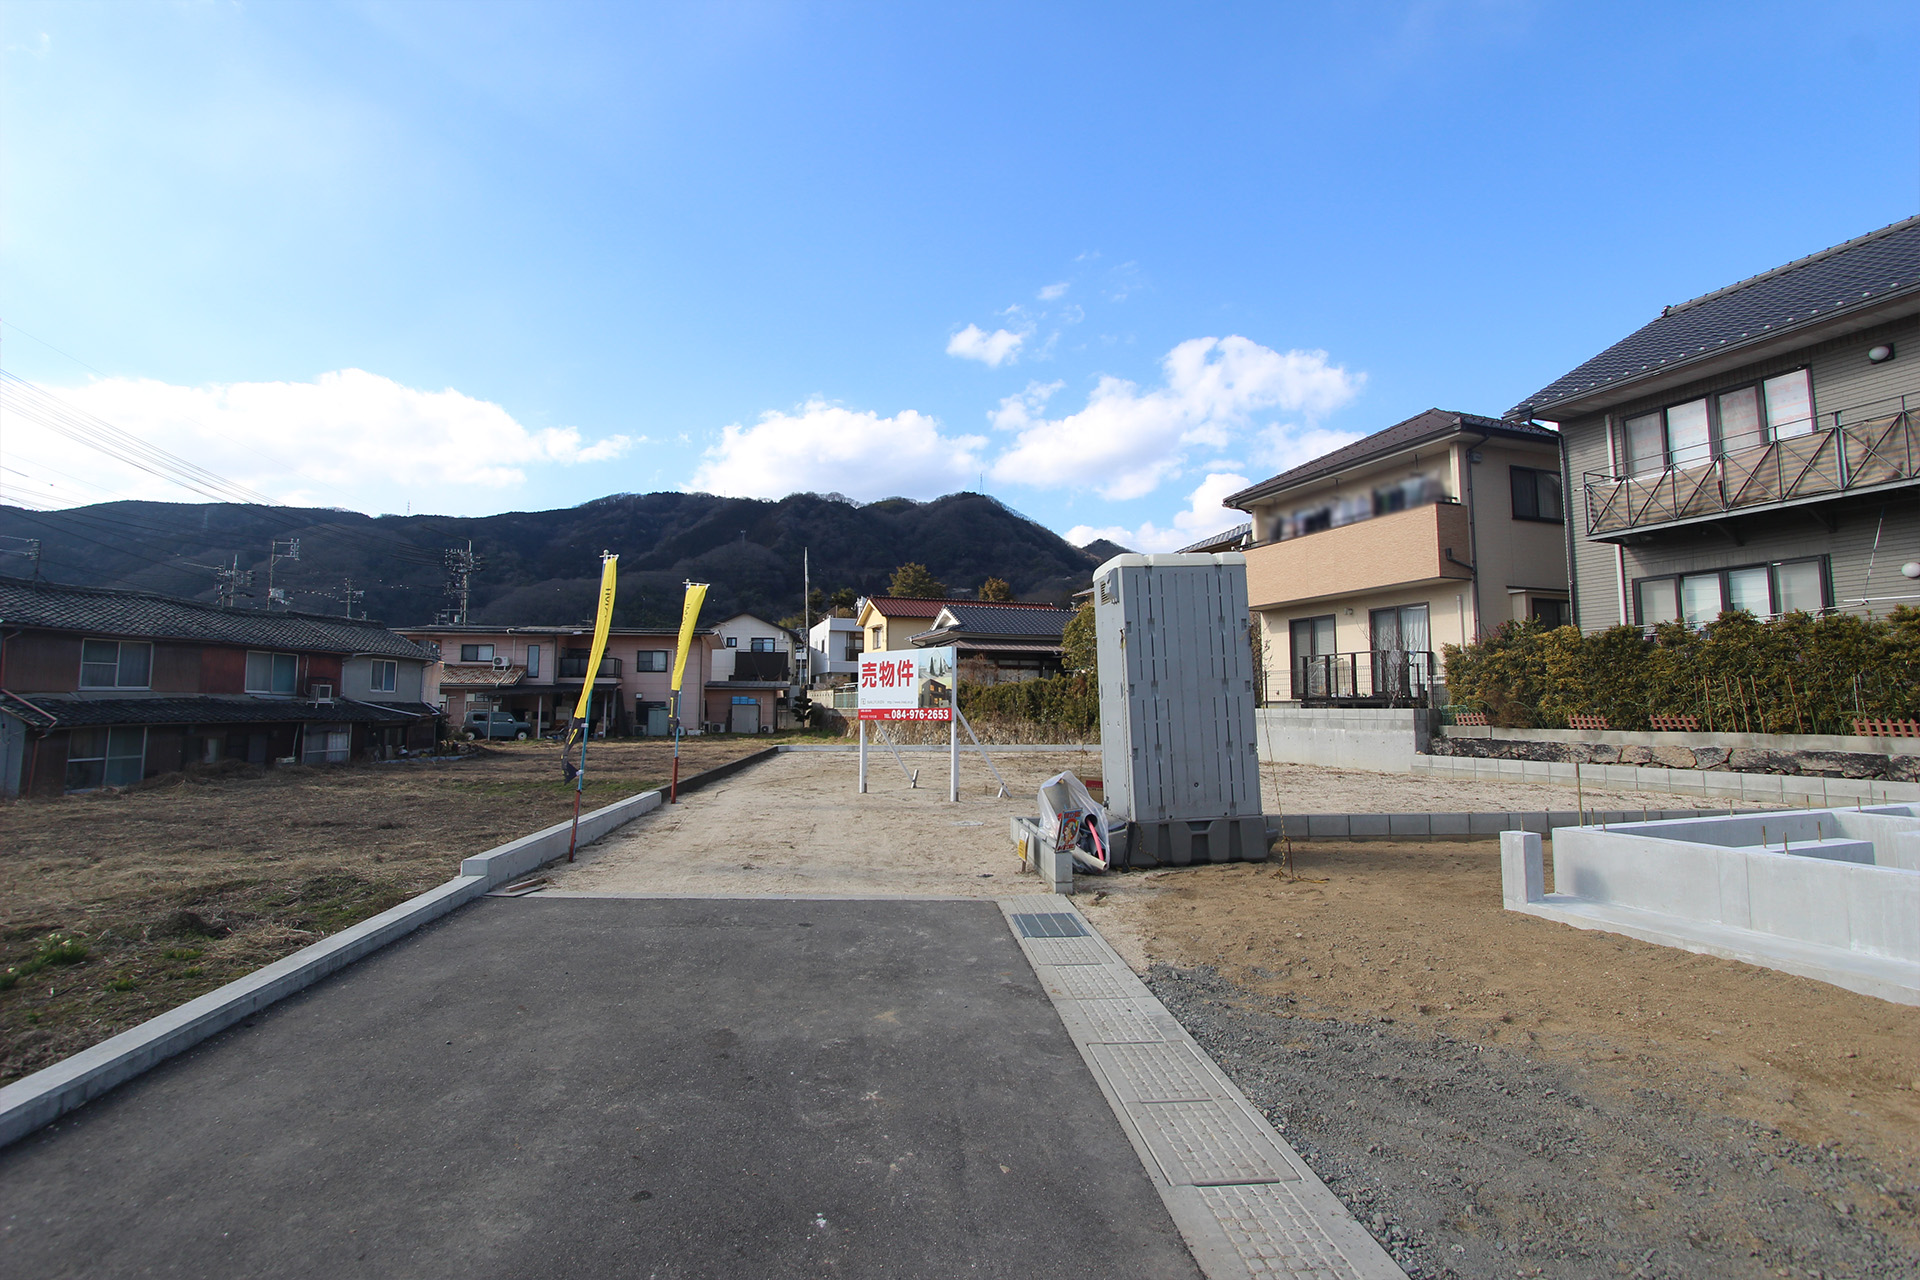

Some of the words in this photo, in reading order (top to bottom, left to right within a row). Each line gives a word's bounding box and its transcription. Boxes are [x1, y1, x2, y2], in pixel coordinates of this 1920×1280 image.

[862, 659, 913, 688] 売物件
[891, 709, 949, 719] 084-976-2653
